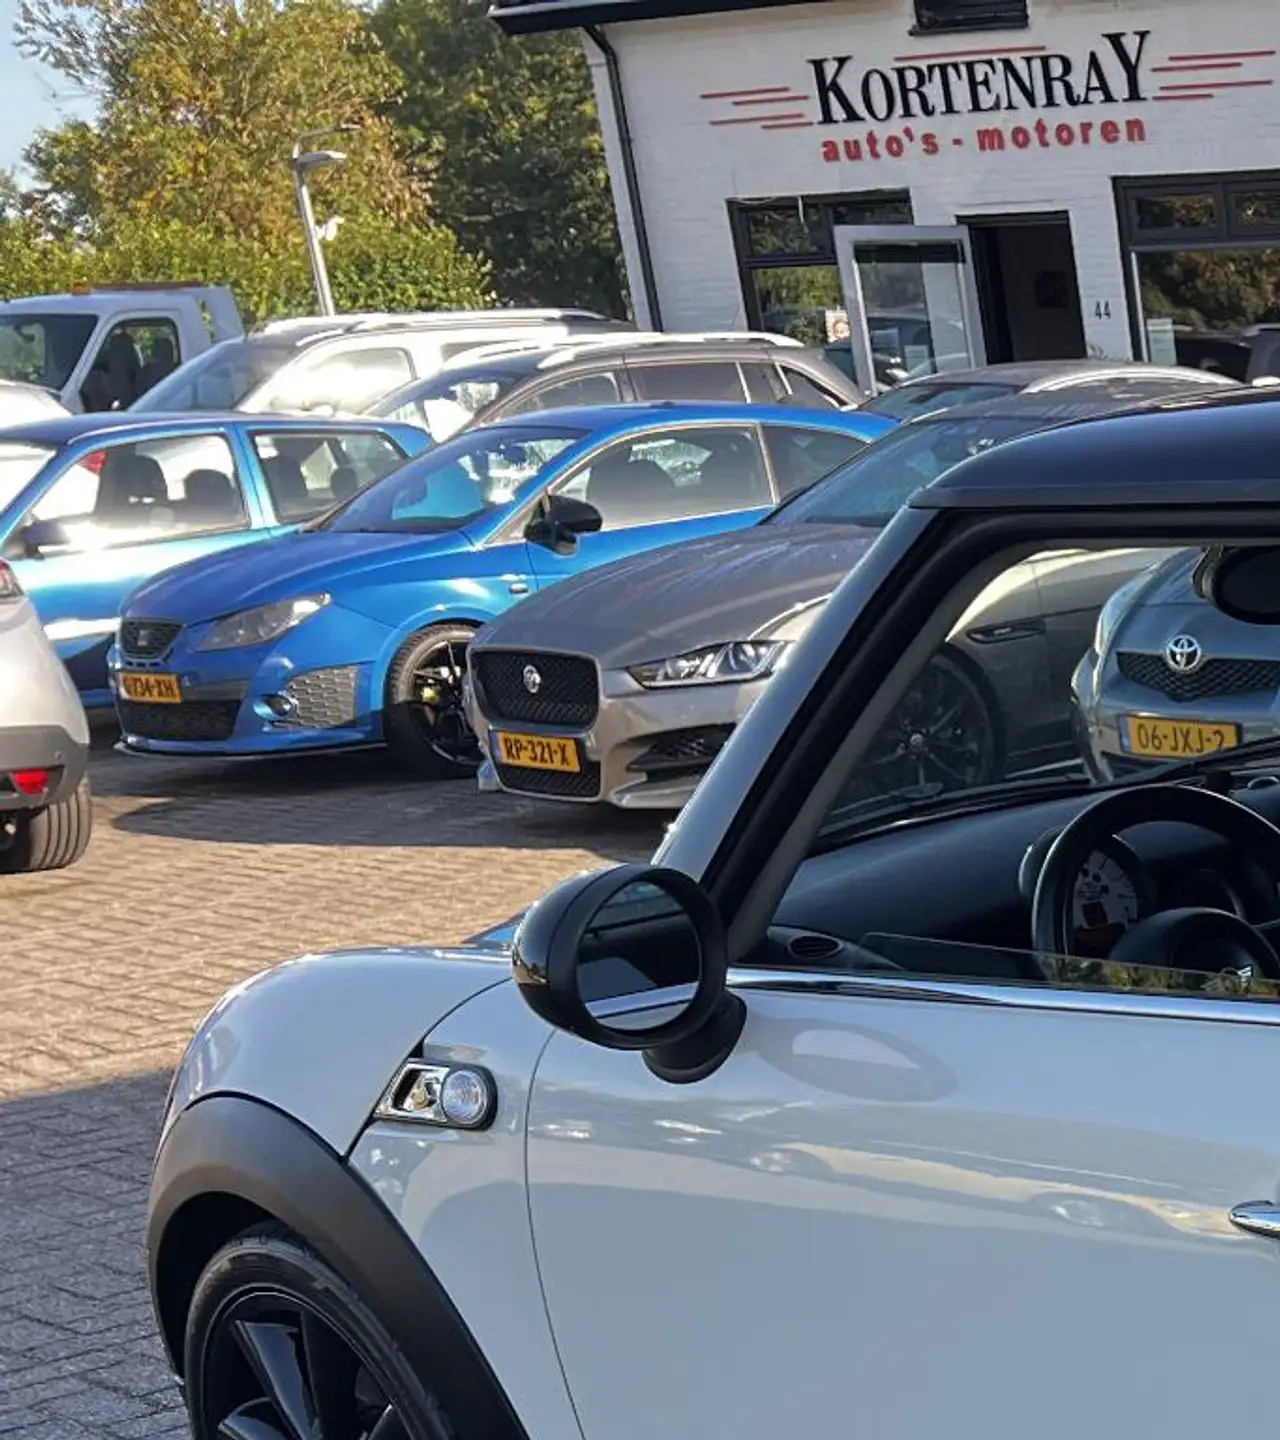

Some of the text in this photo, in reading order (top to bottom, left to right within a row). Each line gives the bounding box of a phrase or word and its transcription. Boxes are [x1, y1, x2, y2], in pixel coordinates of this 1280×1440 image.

[807, 30, 1150, 124] KORTENRAY
[821, 126, 940, 163] auto's
[975, 117, 1147, 152] motoren
[1094, 300, 1112, 321] 44
[503, 735, 570, 767] RP-321-X
